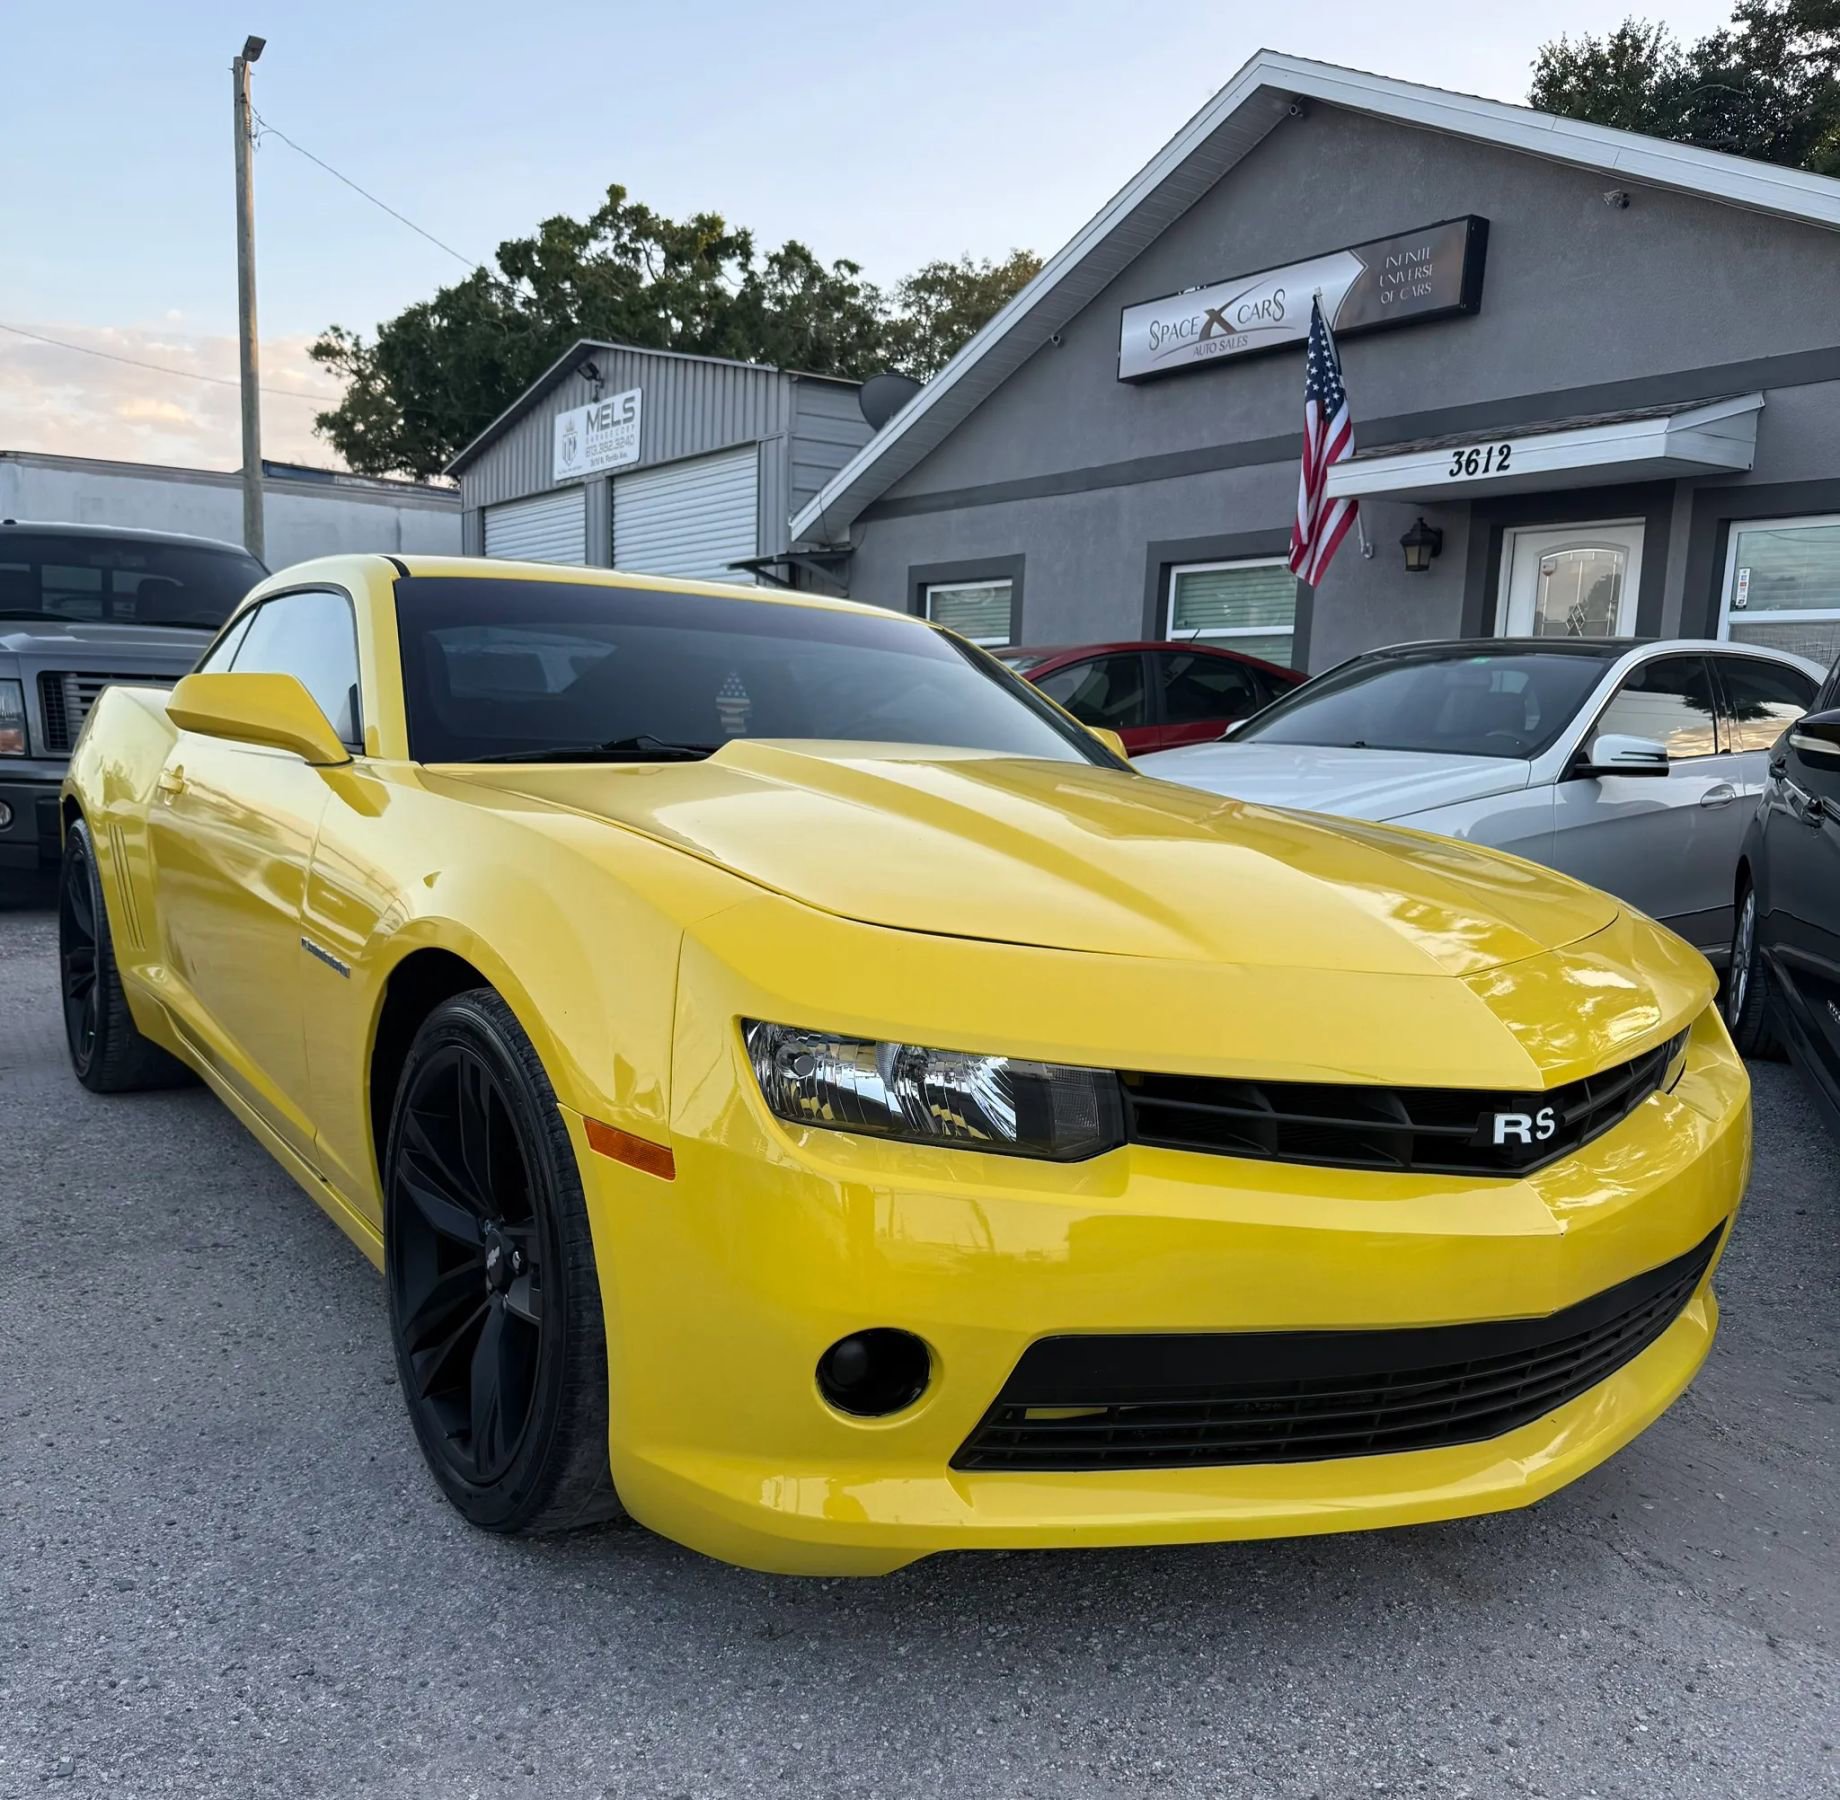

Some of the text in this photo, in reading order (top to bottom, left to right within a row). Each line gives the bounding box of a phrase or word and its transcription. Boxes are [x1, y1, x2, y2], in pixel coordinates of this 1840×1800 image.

[1149, 316, 1200, 351] SPACE
[1237, 288, 1286, 325] CARS
[1193, 335, 1249, 358] AUTO SALES
[586, 395, 636, 436] MELS
[1449, 443, 1512, 477] 3612
[1492, 1106, 1556, 1144] RS
